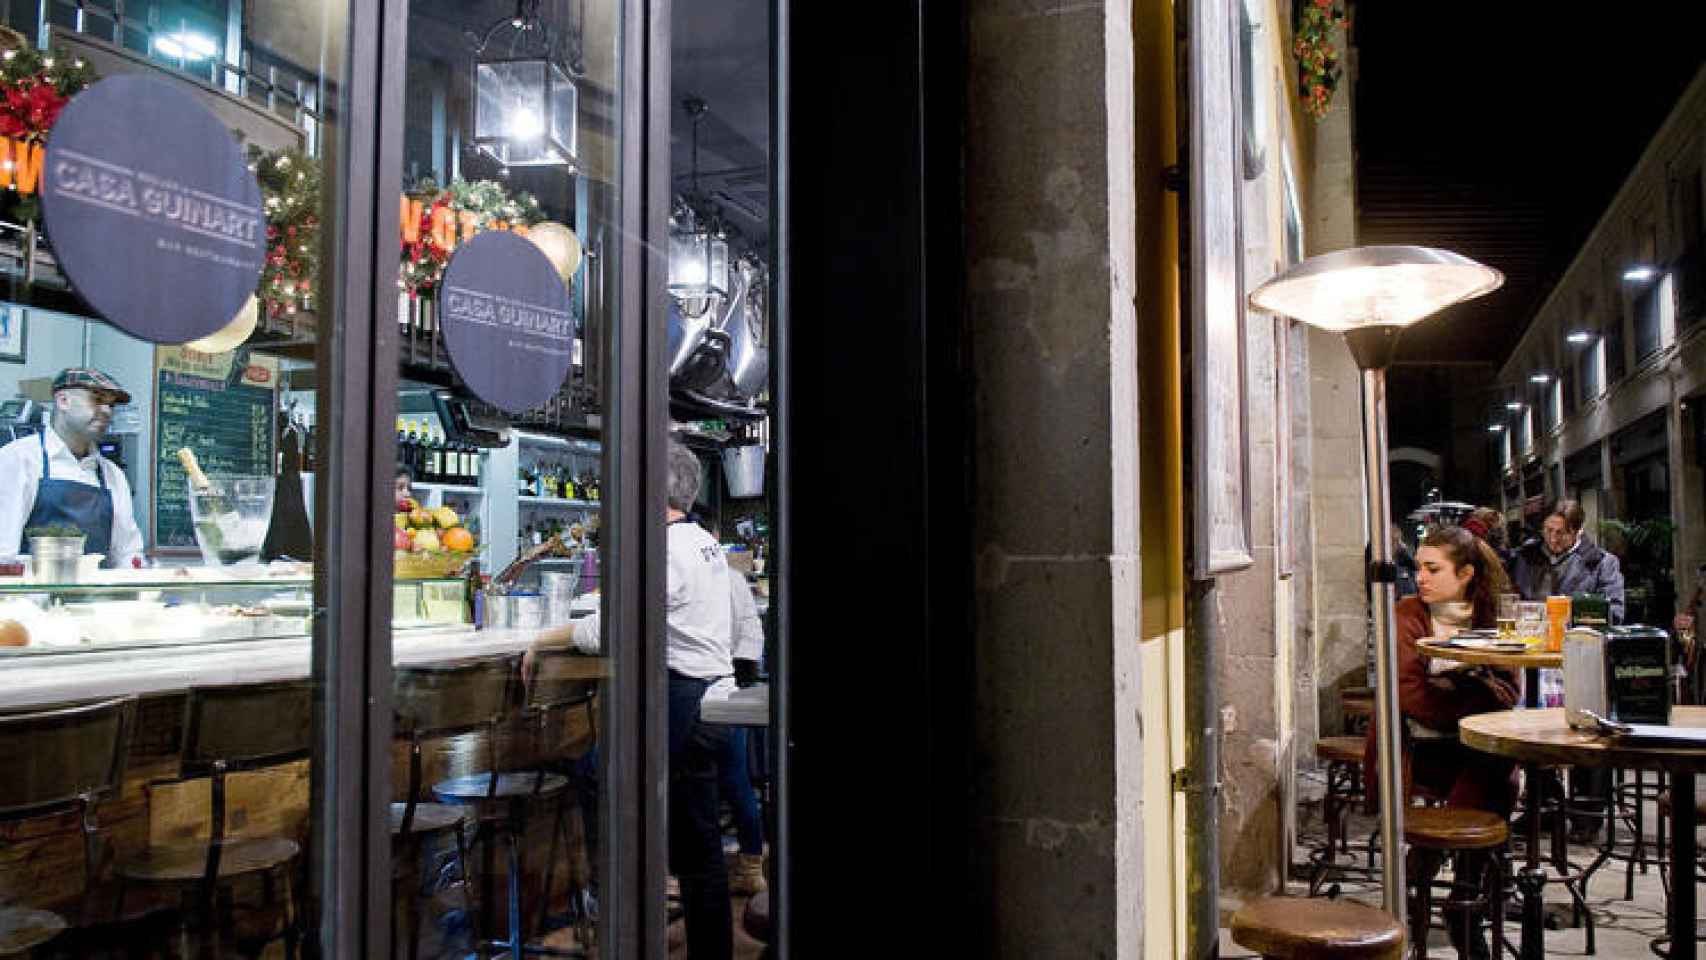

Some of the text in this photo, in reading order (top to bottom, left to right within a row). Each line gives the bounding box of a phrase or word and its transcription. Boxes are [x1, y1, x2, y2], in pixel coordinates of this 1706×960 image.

[56, 161, 138, 208] CASA
[142, 187, 258, 241] GUINART
[447, 293, 570, 335] CASA GUINART
